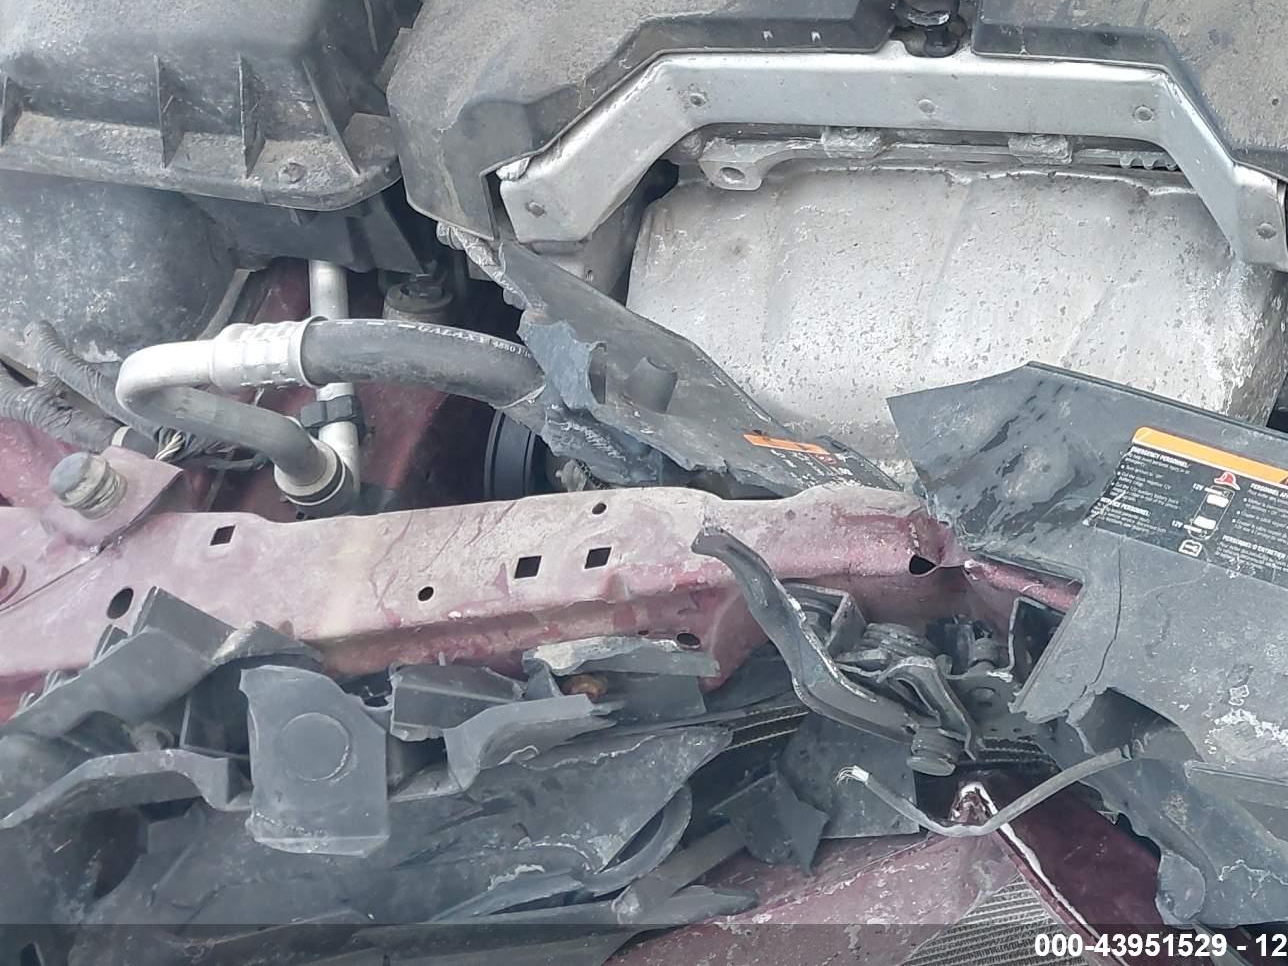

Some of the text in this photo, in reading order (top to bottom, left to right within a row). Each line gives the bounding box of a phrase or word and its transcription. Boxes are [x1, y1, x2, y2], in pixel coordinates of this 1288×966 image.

[417, 323, 487, 344] GALAXY
[1192, 483, 1204, 491] 12V
[1171, 519, 1184, 529] 12V
